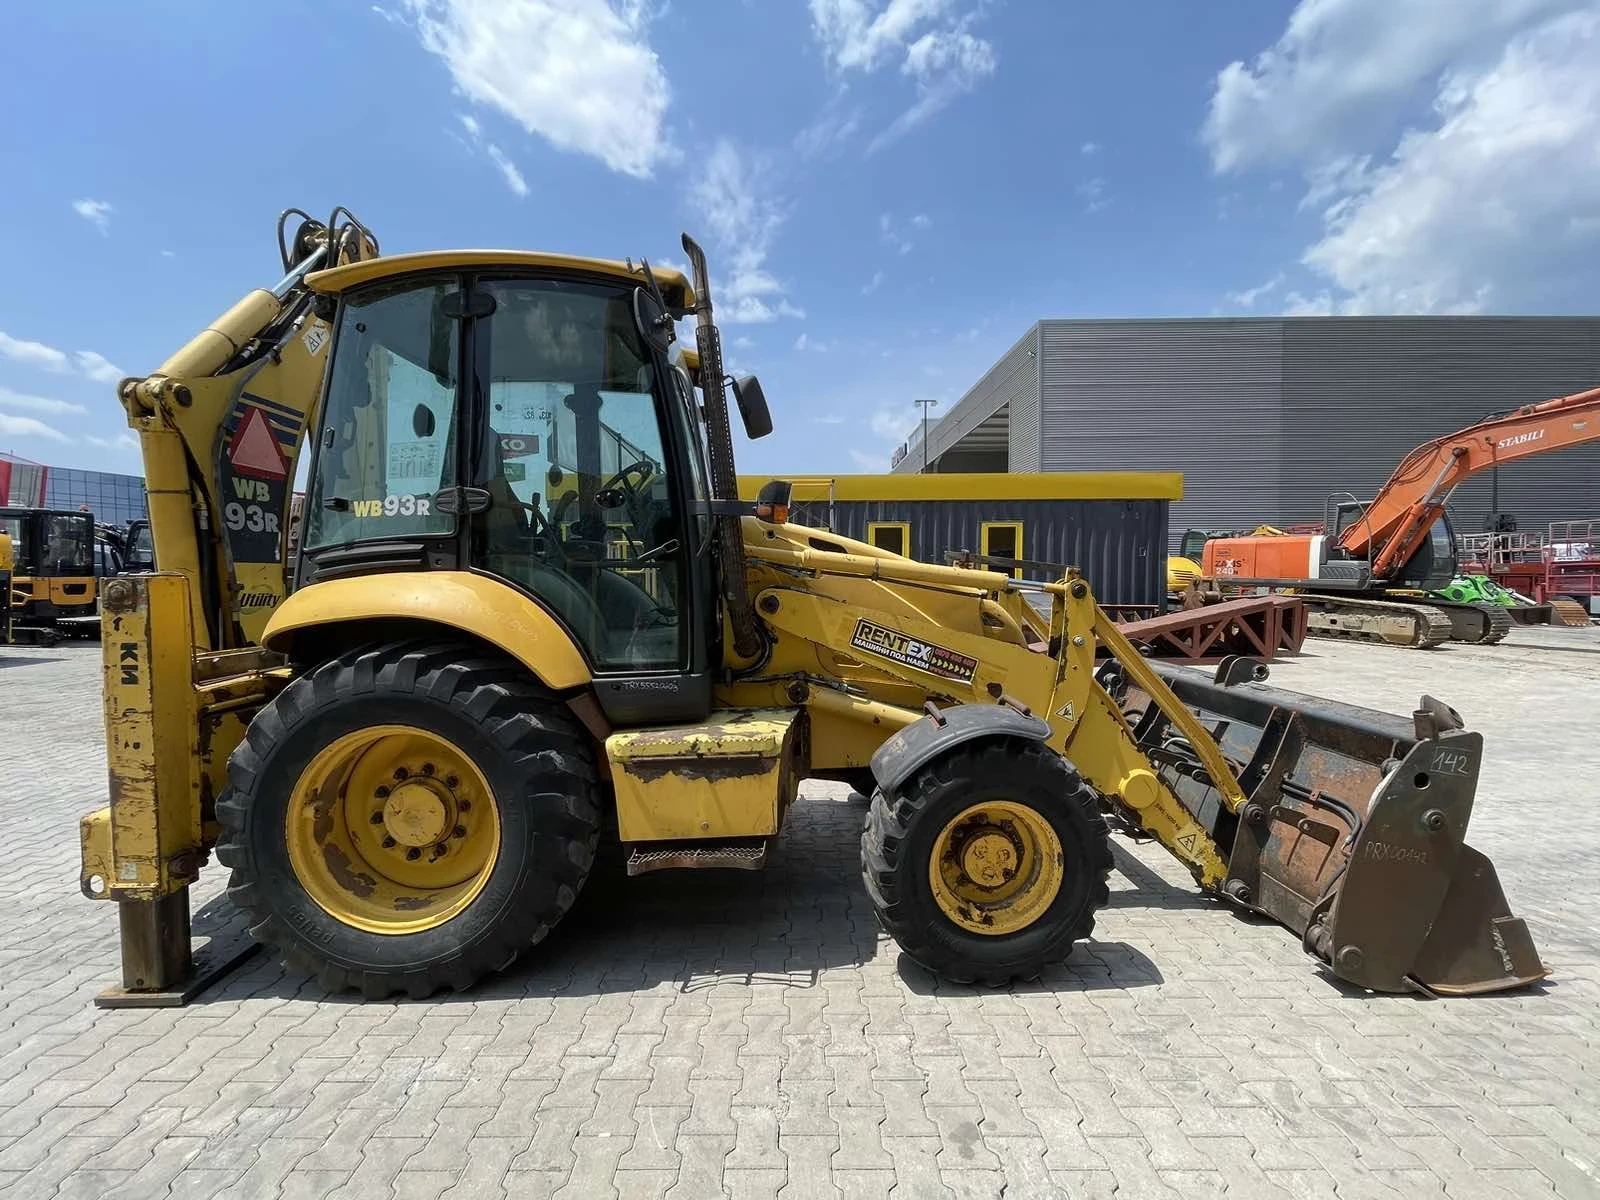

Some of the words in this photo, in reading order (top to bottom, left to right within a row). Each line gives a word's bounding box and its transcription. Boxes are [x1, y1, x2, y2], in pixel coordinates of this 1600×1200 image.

[1498, 429, 1545, 448] STABILI
[231, 477, 270, 502] WB
[225, 502, 279, 533] 93R
[240, 592, 281, 609] Utility
[854, 638, 890, 656] МАШИНИ
[889, 651, 906, 662] ПОД
[906, 656, 930, 669] НАЕМ
[858, 623, 932, 661] RENTEX
[1433, 751, 1469, 774] 142
